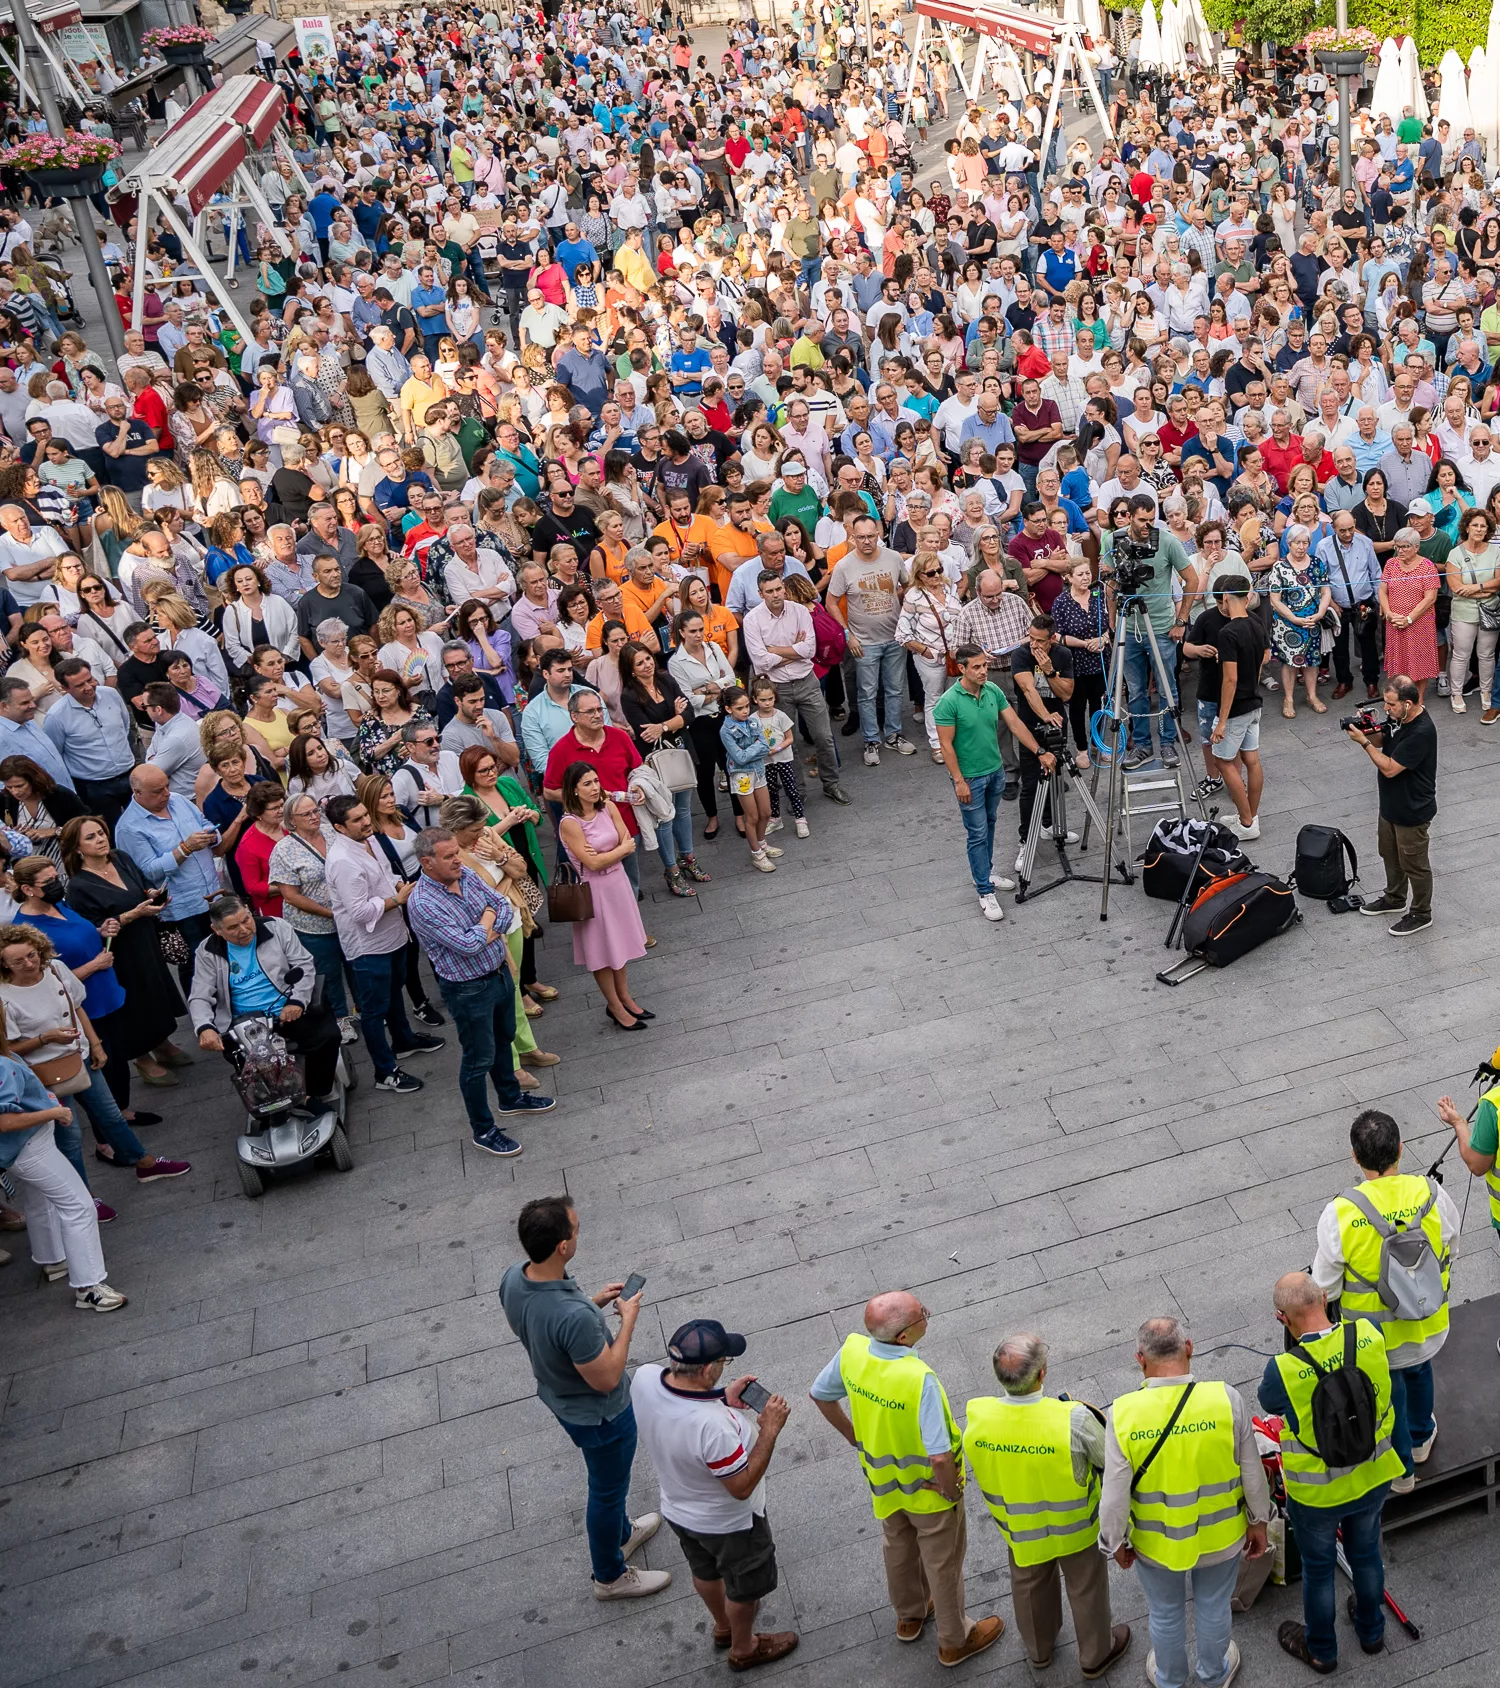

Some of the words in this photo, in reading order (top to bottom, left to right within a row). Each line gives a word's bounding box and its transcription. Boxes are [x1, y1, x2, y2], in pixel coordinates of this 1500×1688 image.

[302, 19, 323, 29] Aula
[1314, 80, 1318, 90] 7
[232, 969, 263, 986] LUCENA
[1129, 1420, 1217, 1442] ORGAIZACIÓN
[975, 1439, 1056, 1455] ORGANIZACIÓN
